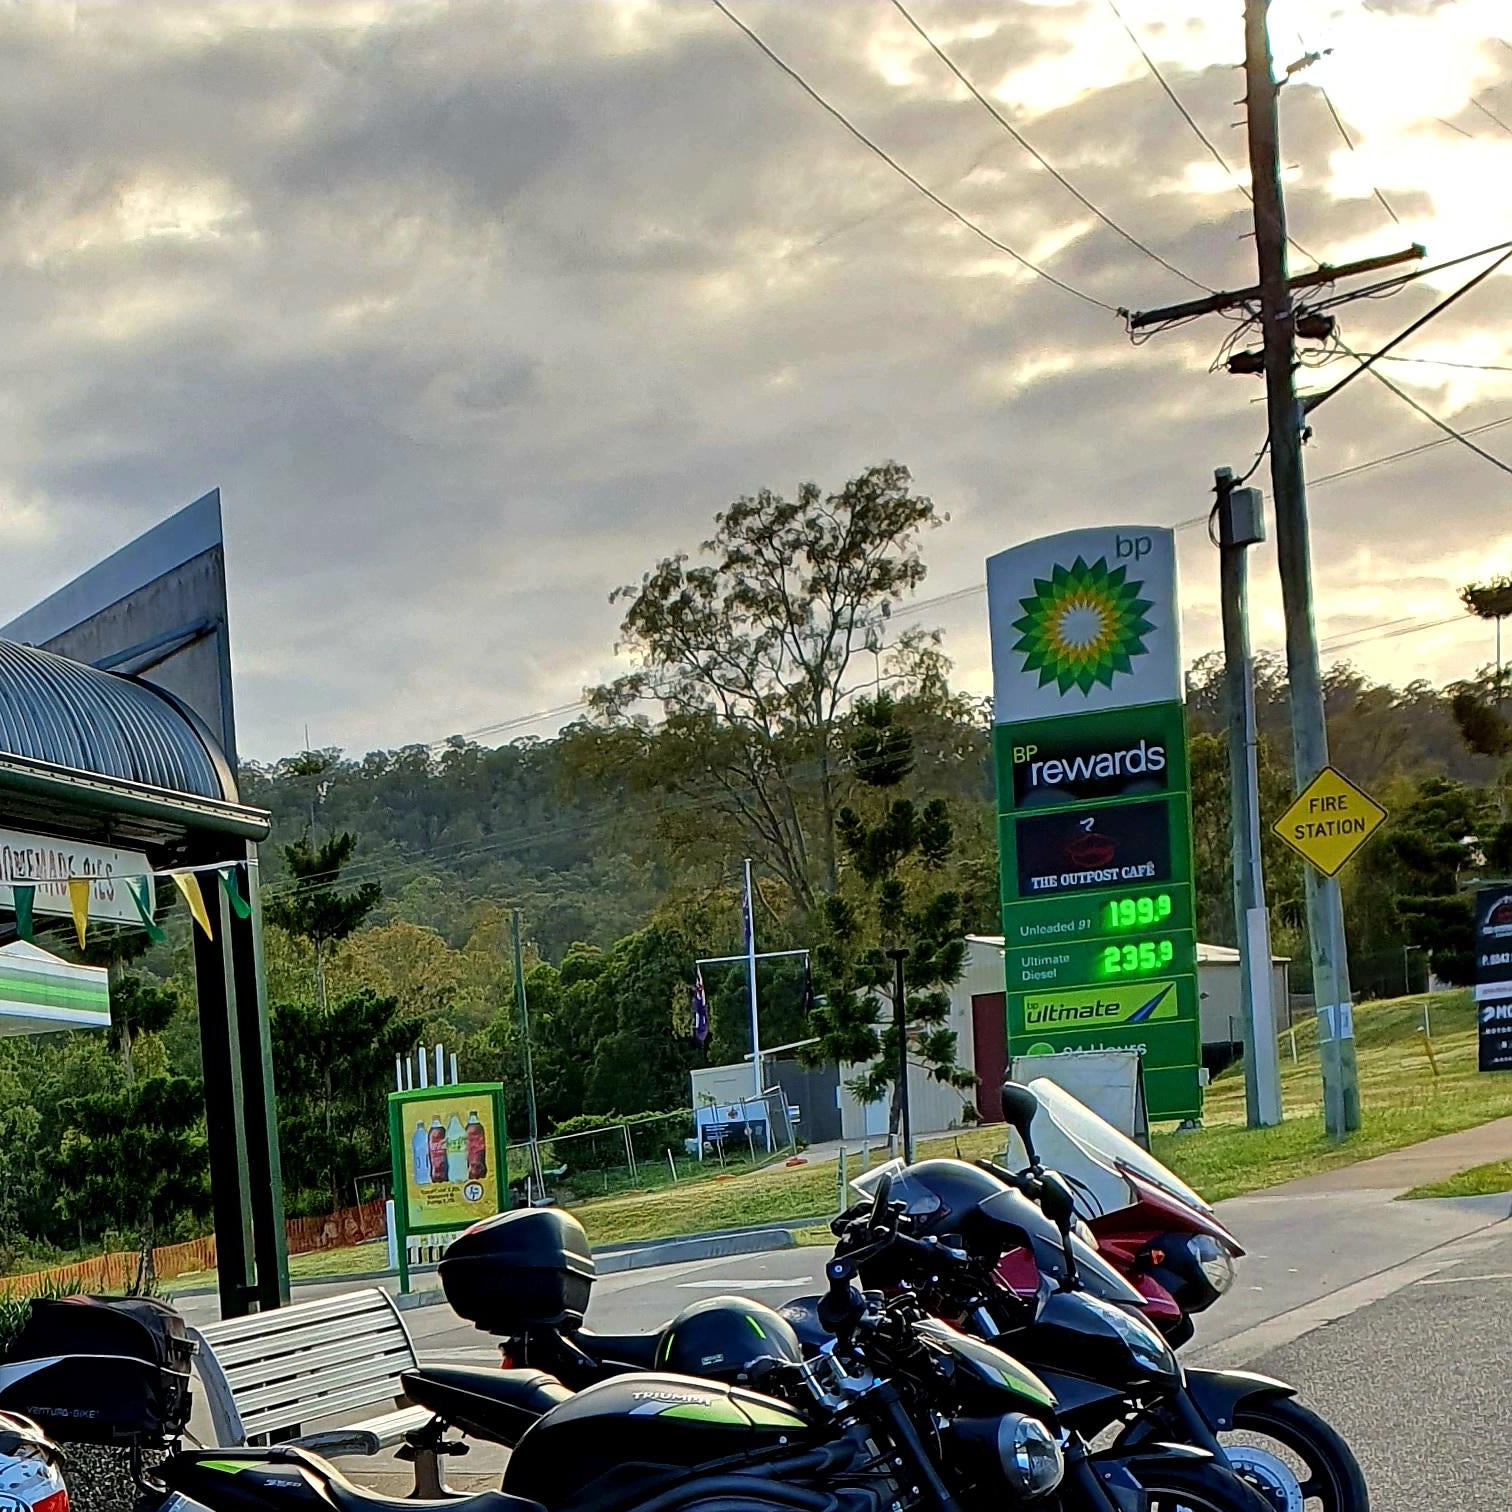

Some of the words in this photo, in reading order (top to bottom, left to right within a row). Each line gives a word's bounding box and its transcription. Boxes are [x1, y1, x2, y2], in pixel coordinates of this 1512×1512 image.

[1116, 534, 1152, 561] bp
[1013, 745, 1038, 763] BP
[1031, 740, 1166, 786] rewards
[1309, 795, 1348, 813] FIRE
[1295, 817, 1365, 839] STATION
[1031, 875, 1057, 889] THE
[1060, 868, 1119, 885] OUTPOST
[1110, 894, 1171, 927] 199.9
[1020, 920, 1075, 937] Unleaded
[1078, 919, 1091, 931] 91
[1021, 954, 1070, 967] Ultimate
[1103, 940, 1173, 973] 235.9
[1022, 969, 1057, 982] Diesel
[1027, 1000, 1120, 1024] ultimate
[632, 1391, 711, 1407] TRIUMPH
